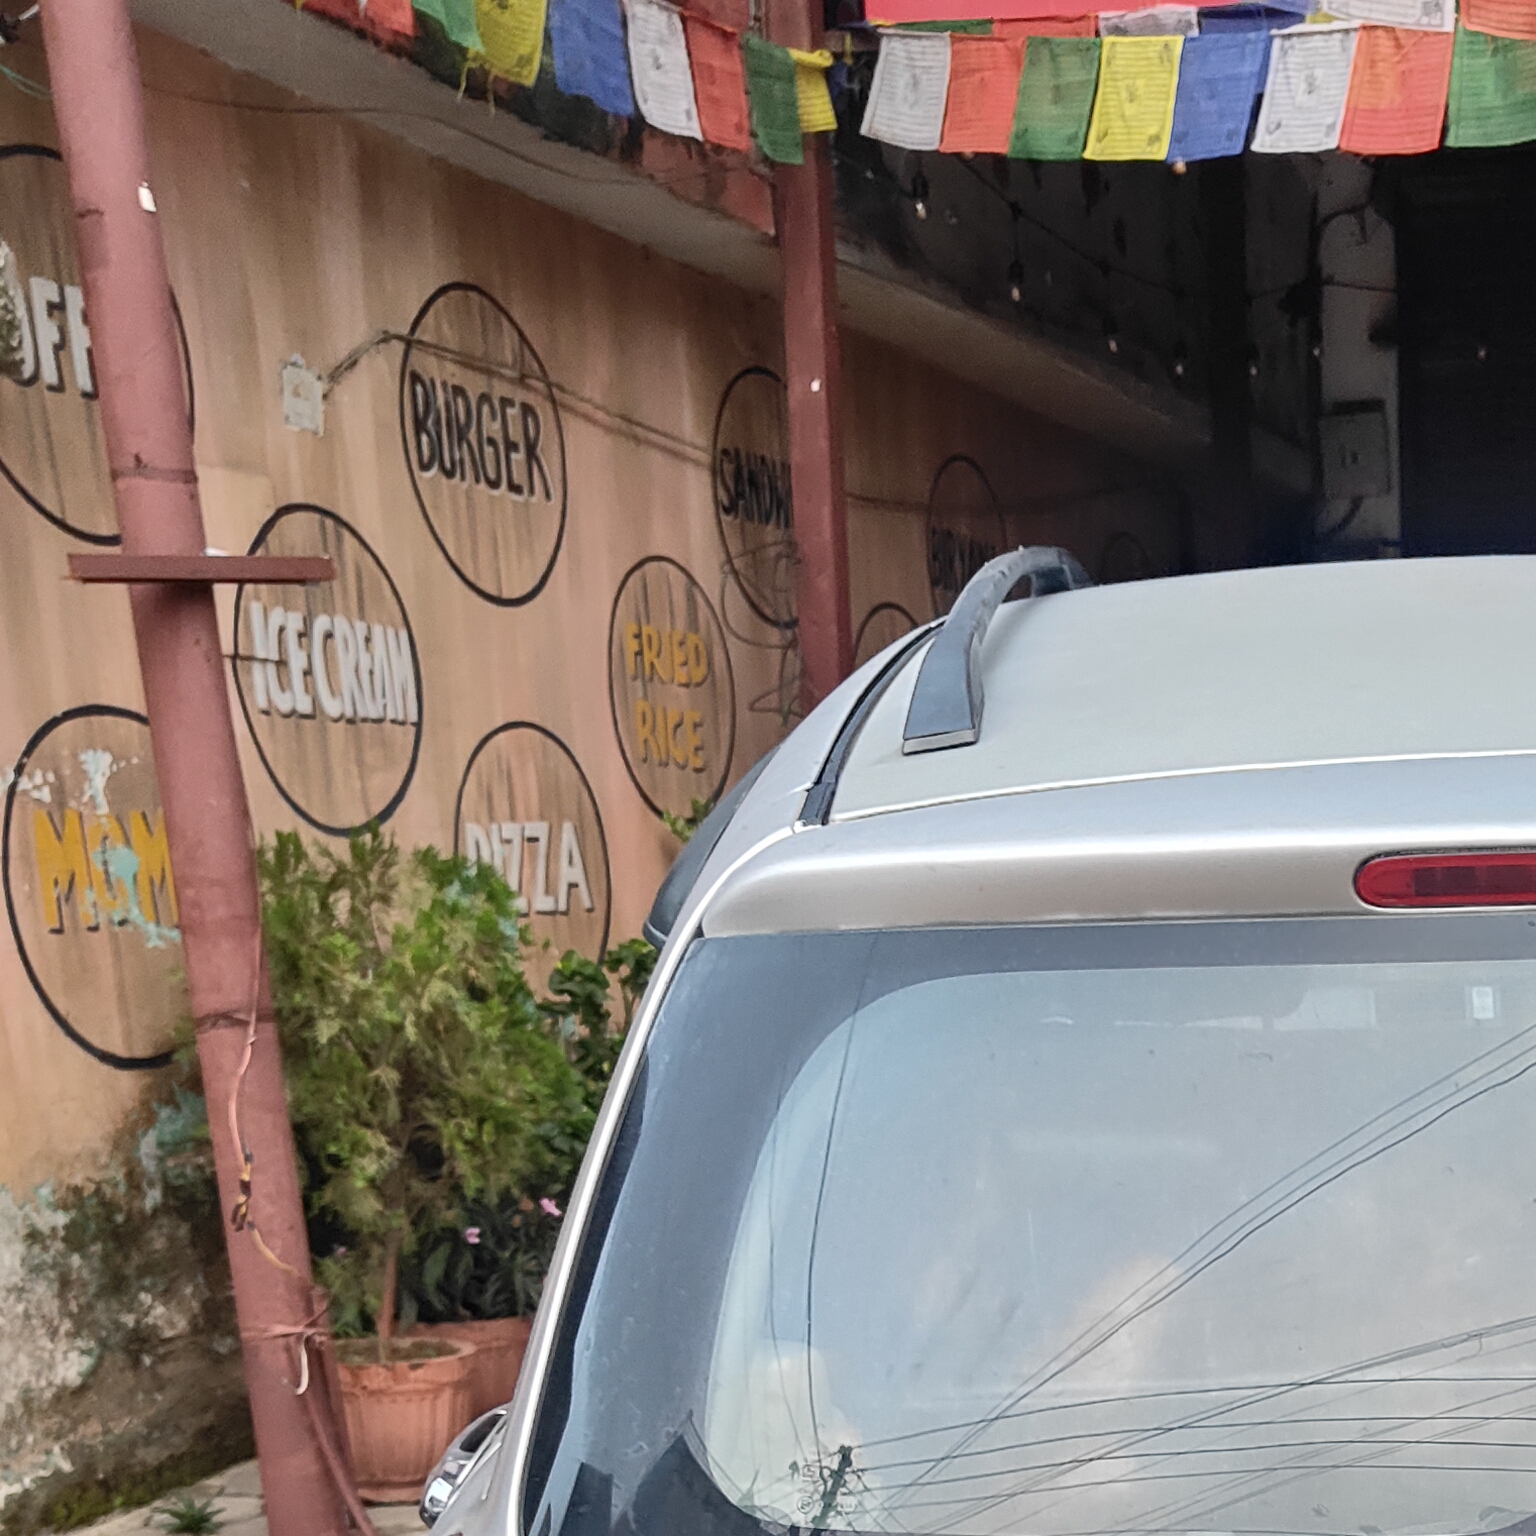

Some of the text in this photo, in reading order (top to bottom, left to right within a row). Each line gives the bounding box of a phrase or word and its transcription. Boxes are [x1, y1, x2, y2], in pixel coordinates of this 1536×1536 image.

[409, 368, 553, 502] BURGER
[251, 601, 419, 725] ICE CREAM
[624, 621, 708, 688] FRIED
[635, 697, 705, 773] RICE
